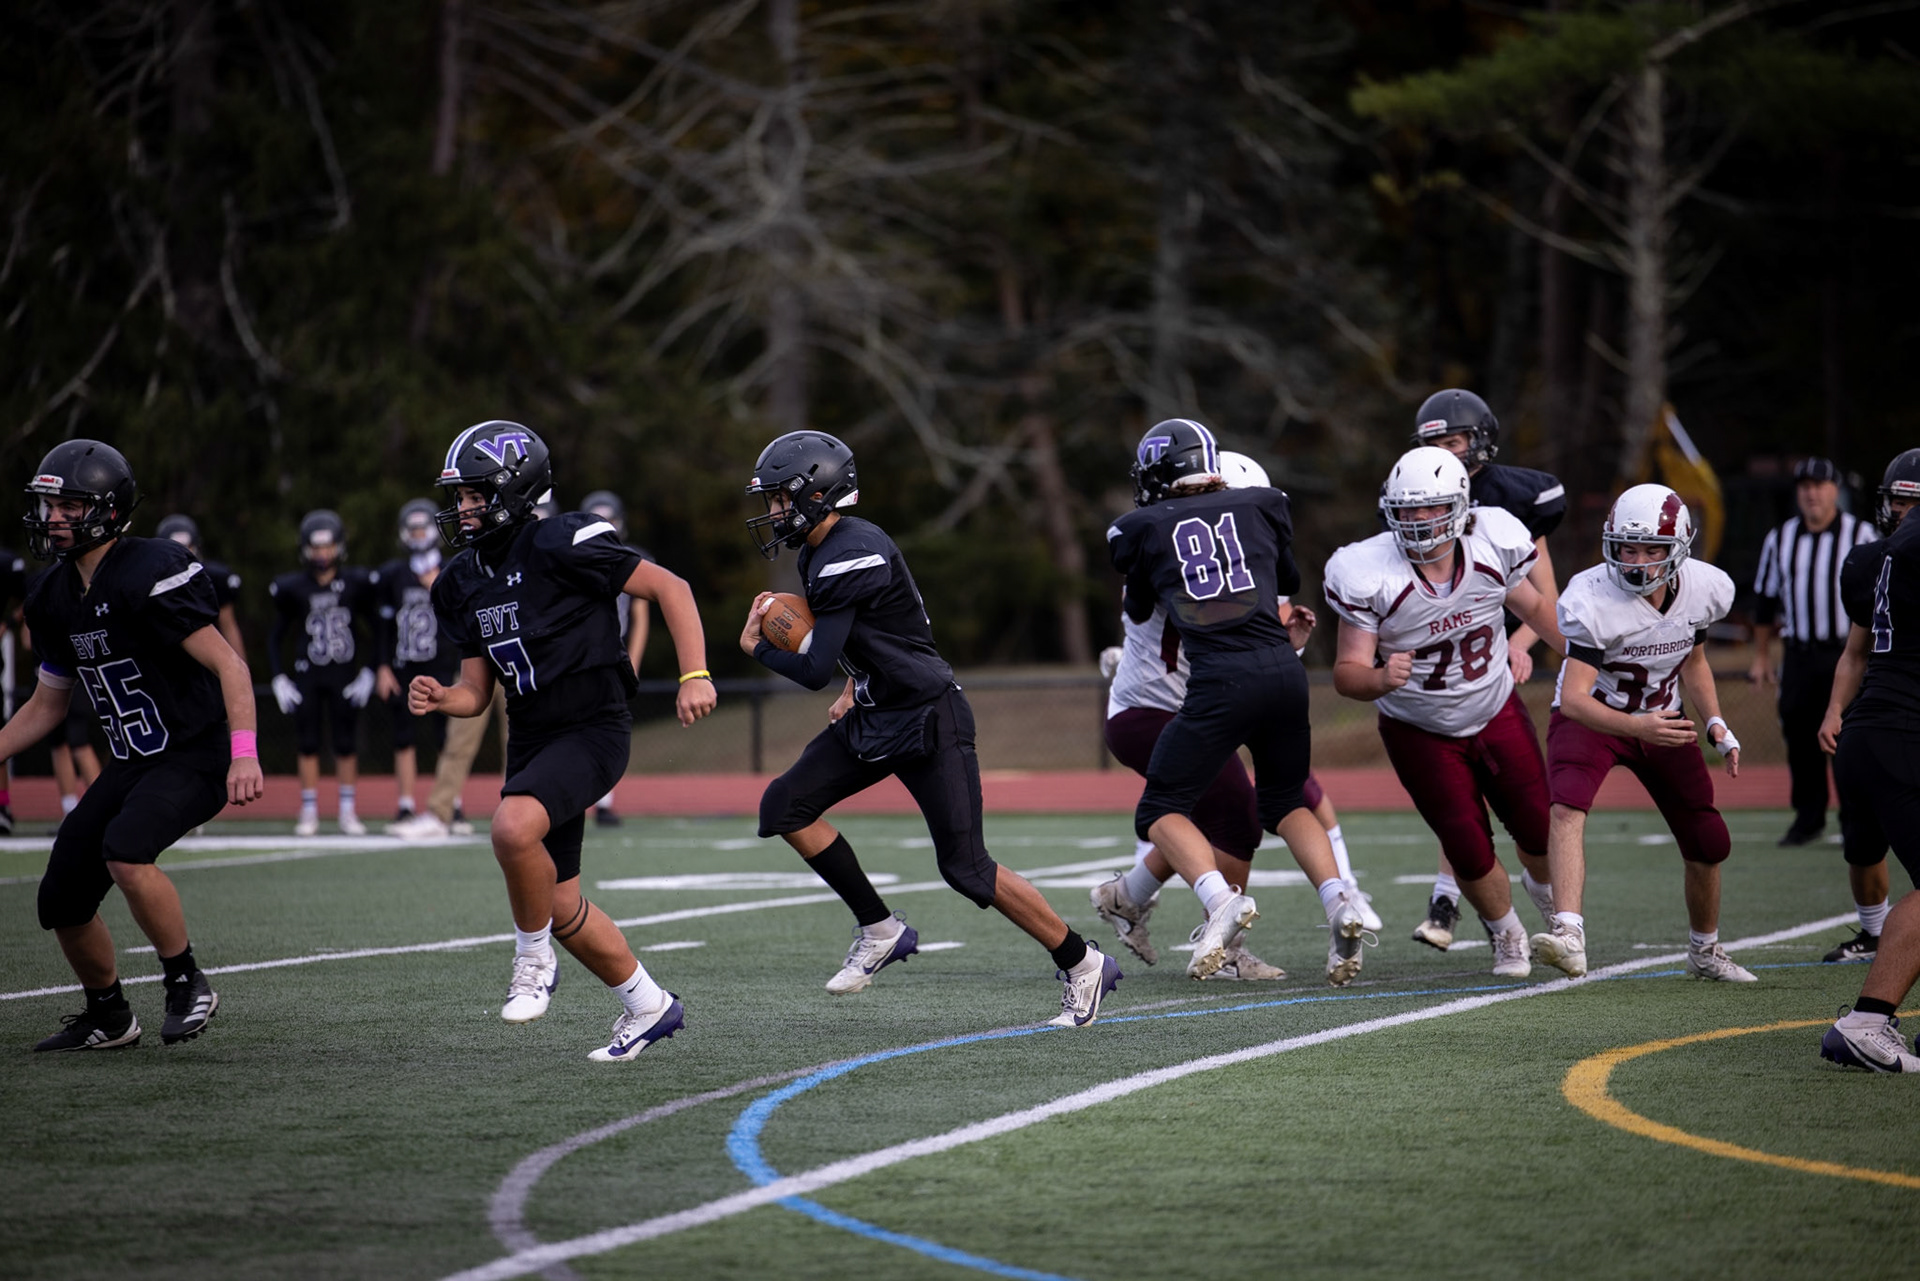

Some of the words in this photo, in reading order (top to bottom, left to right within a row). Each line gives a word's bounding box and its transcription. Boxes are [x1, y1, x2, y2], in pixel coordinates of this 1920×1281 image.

[473, 432, 531, 467] VT
[1172, 512, 1256, 600] 81
[476, 601, 519, 638] BVT
[1429, 610, 1473, 635] RAMS
[70, 629, 111, 659] BVT
[488, 637, 538, 696] 7
[1415, 625, 1493, 690] 78
[1622, 638, 1693, 656] NORTHBRIDG
[1593, 654, 1689, 714] 34
[77, 658, 169, 760] 55
